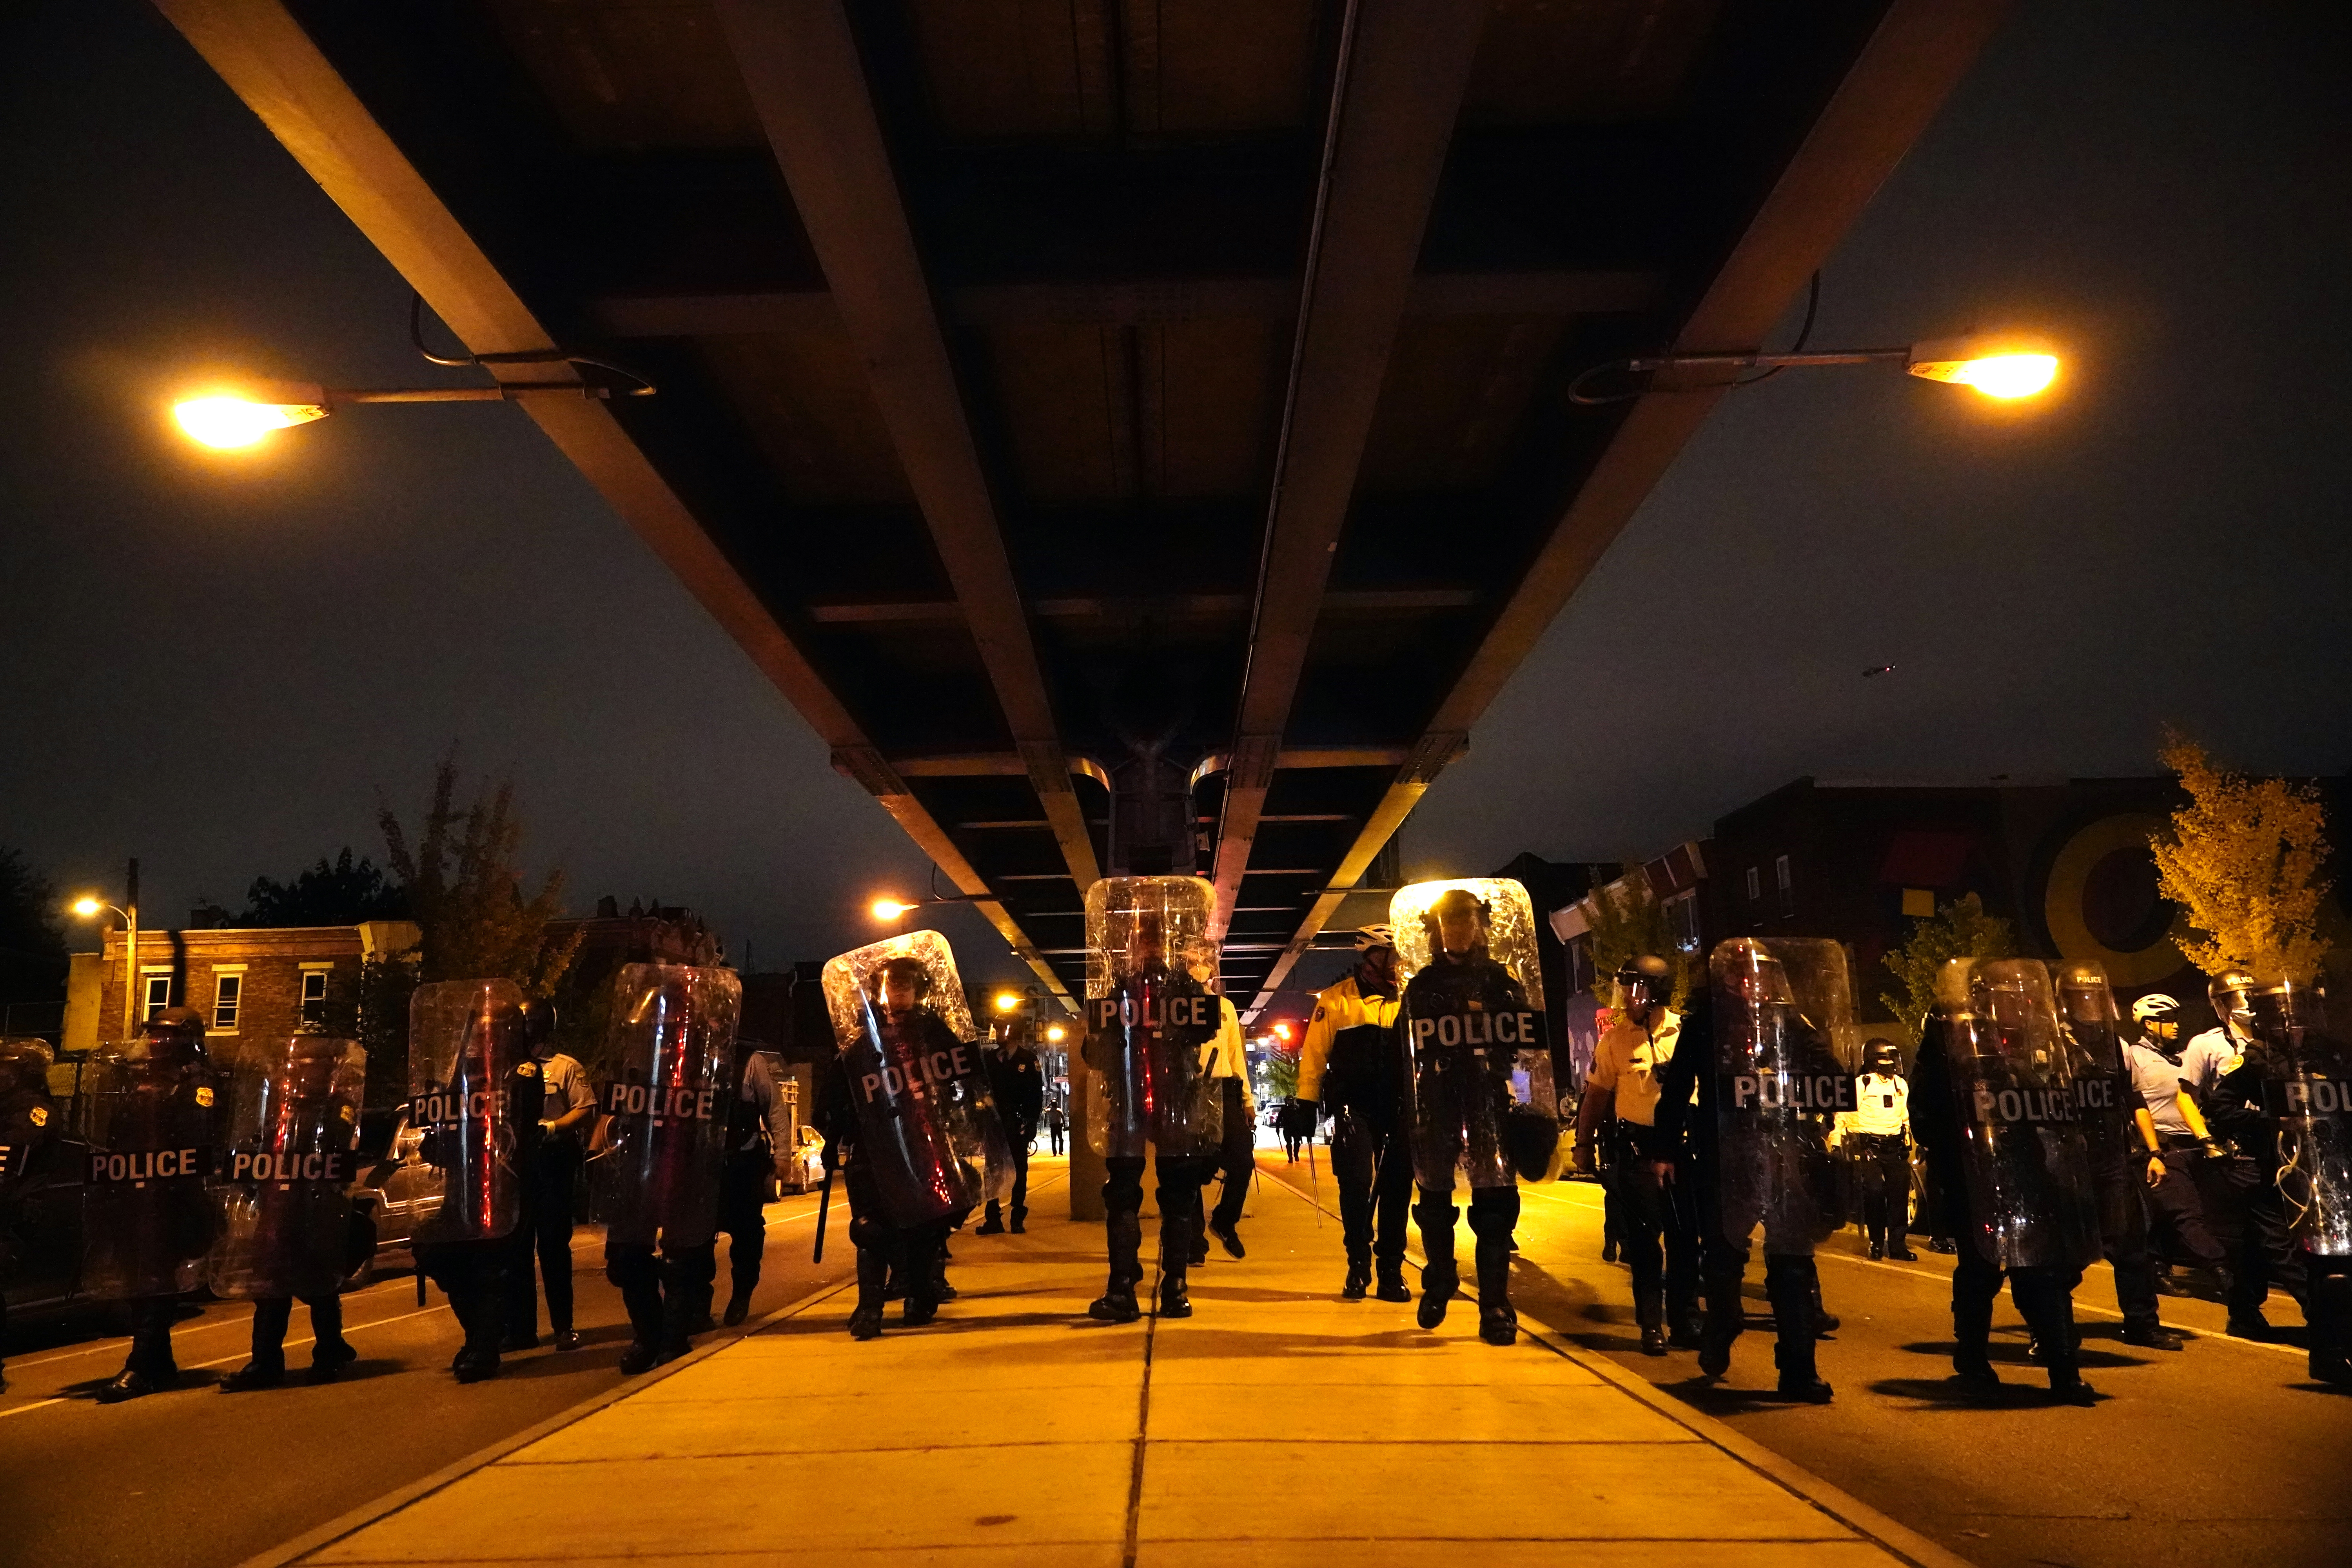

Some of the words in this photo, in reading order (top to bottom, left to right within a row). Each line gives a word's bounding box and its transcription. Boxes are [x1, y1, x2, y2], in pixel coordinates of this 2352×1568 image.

[2227, 976, 2254, 985] POLICE
[1100, 997, 1207, 1029] POLICE
[1415, 1012, 1535, 1050] POLICE
[862, 1046, 971, 1103] POLICE
[610, 1084, 712, 1119] POLICE
[1734, 1076, 1849, 1107] POLICE
[1973, 1090, 2074, 1122] POLICE
[2078, 1080, 2113, 1108] ICE
[2285, 1081, 2352, 1112] POL
[415, 1092, 506, 1124] POLICE
[93, 1149, 196, 1181] POLICE
[233, 1153, 342, 1180] POLICE
